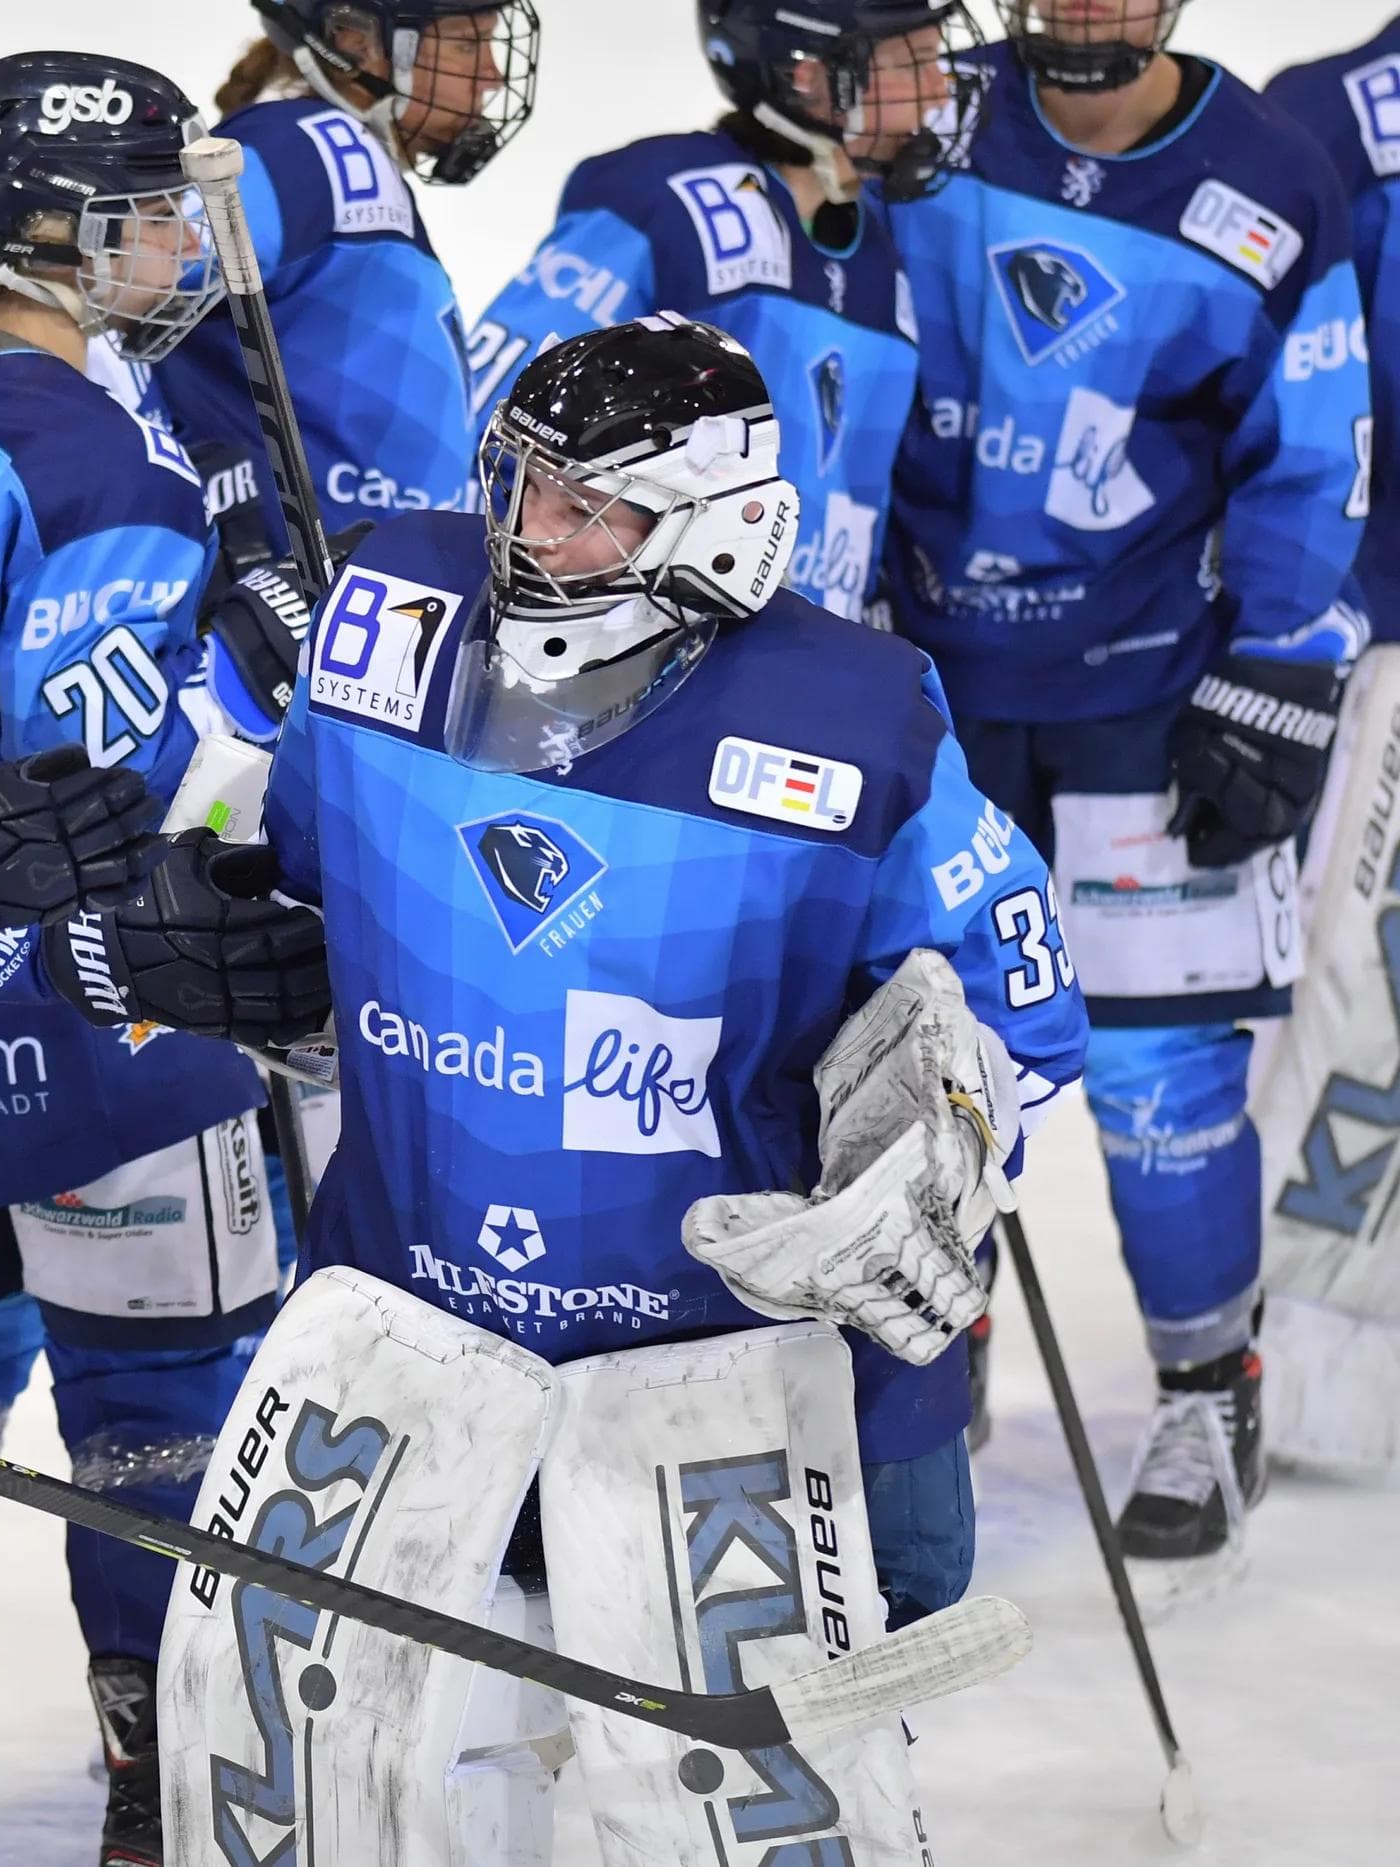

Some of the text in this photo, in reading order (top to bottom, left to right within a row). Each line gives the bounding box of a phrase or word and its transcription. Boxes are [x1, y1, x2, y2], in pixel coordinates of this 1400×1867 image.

[38, 79, 133, 134] gsb
[684, 171, 752, 262] B
[508, 404, 569, 448] BAUER
[750, 500, 792, 600] BAUER
[319, 574, 388, 681] B
[43, 625, 168, 769] 20
[316, 676, 416, 724] SYSTEMS
[540, 896, 605, 959] FRAUEN
[357, 1000, 710, 1138] canada life
[132, 1207, 183, 1225] Radio
[559, 1309, 642, 1330] BRAND
[804, 1467, 852, 1662] BAUE
